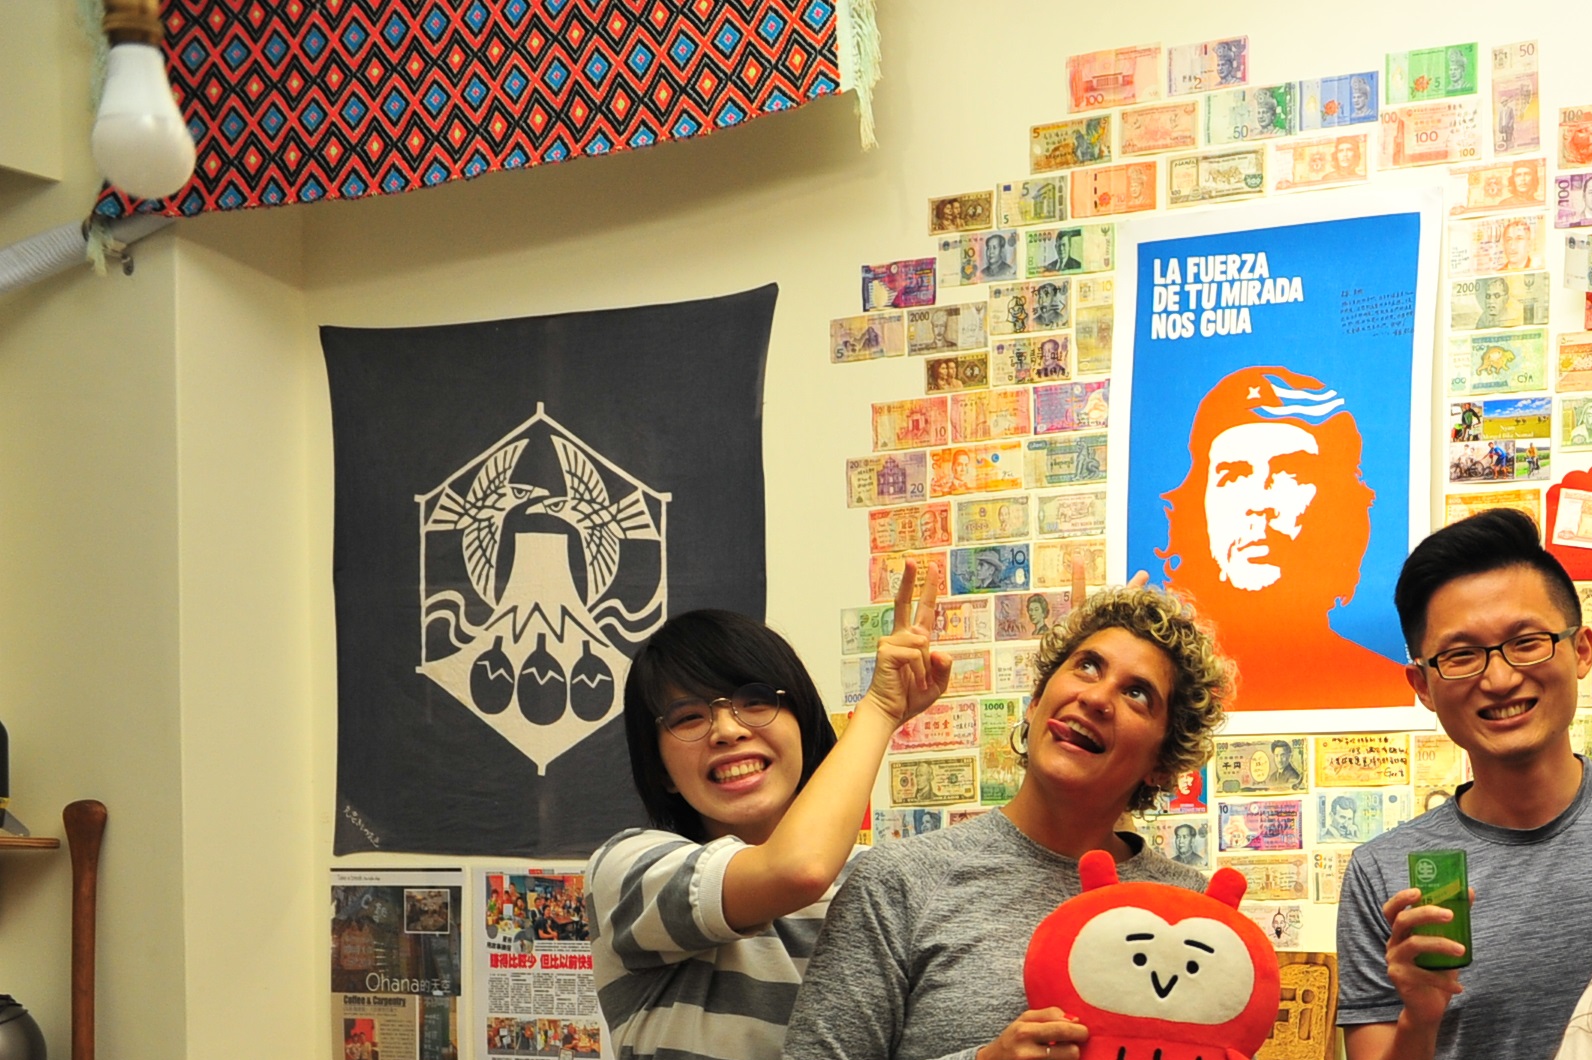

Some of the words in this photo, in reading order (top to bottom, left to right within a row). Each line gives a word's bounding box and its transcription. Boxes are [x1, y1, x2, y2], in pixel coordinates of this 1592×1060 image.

[1519, 43, 1535, 57] 50
[1193, 77, 1202, 90] 2
[1434, 77, 1441, 88] 5
[1085, 92, 1104, 105] 100
[1380, 112, 1398, 125] 100
[1562, 109, 1583, 122] 100
[1032, 127, 1040, 139] 5
[1232, 125, 1249, 139] 50
[1414, 131, 1438, 144] 100
[1459, 147, 1475, 158] 100
[1020, 182, 1030, 197] 5
[1558, 179, 1570, 207] 100
[1002, 213, 1009, 224] 5
[1028, 231, 1052, 243] 20000
[963, 247, 976, 259] 10
[1153, 257, 1182, 285] LA
[1186, 251, 1270, 284] FUERZA
[1456, 282, 1481, 294] 2000
[1152, 284, 1180, 313] DE
[1184, 281, 1218, 310] TU
[1221, 276, 1304, 308] MIRADA
[910, 311, 930, 322] 2000
[1151, 311, 1195, 340] NOS
[1200, 307, 1252, 338] GUIA
[836, 348, 845, 359] 5
[934, 426, 947, 438] 10
[910, 483, 924, 495] 20
[1010, 548, 1026, 565] 10
[1063, 591, 1070, 602] 5
[984, 703, 1005, 711] 1000
[1416, 750, 1436, 761] 100
[1221, 760, 1243, 770] 千円
[1219, 804, 1228, 815] 10
[1151, 834, 1164, 846] 10
[1314, 853, 1323, 868] 20
[343, 995, 365, 1004] Coffee
[373, 996, 406, 1007] Carpentry
